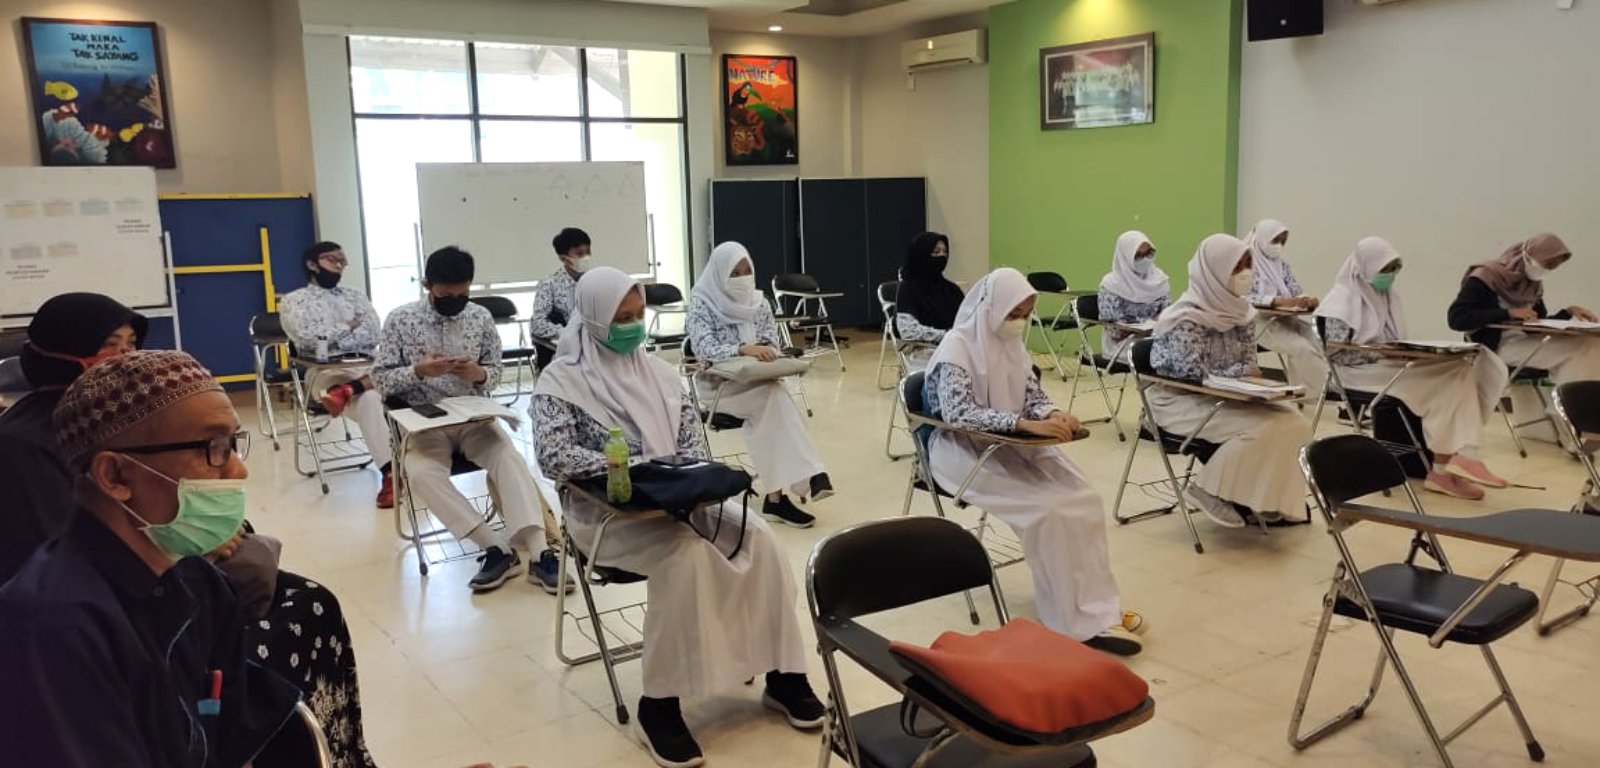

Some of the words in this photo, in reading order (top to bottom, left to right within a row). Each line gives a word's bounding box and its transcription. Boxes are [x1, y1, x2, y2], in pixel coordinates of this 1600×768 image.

[68, 32, 89, 41] TAK
[95, 51, 139, 61] SAYANG
[728, 68, 775, 82] NATURE
